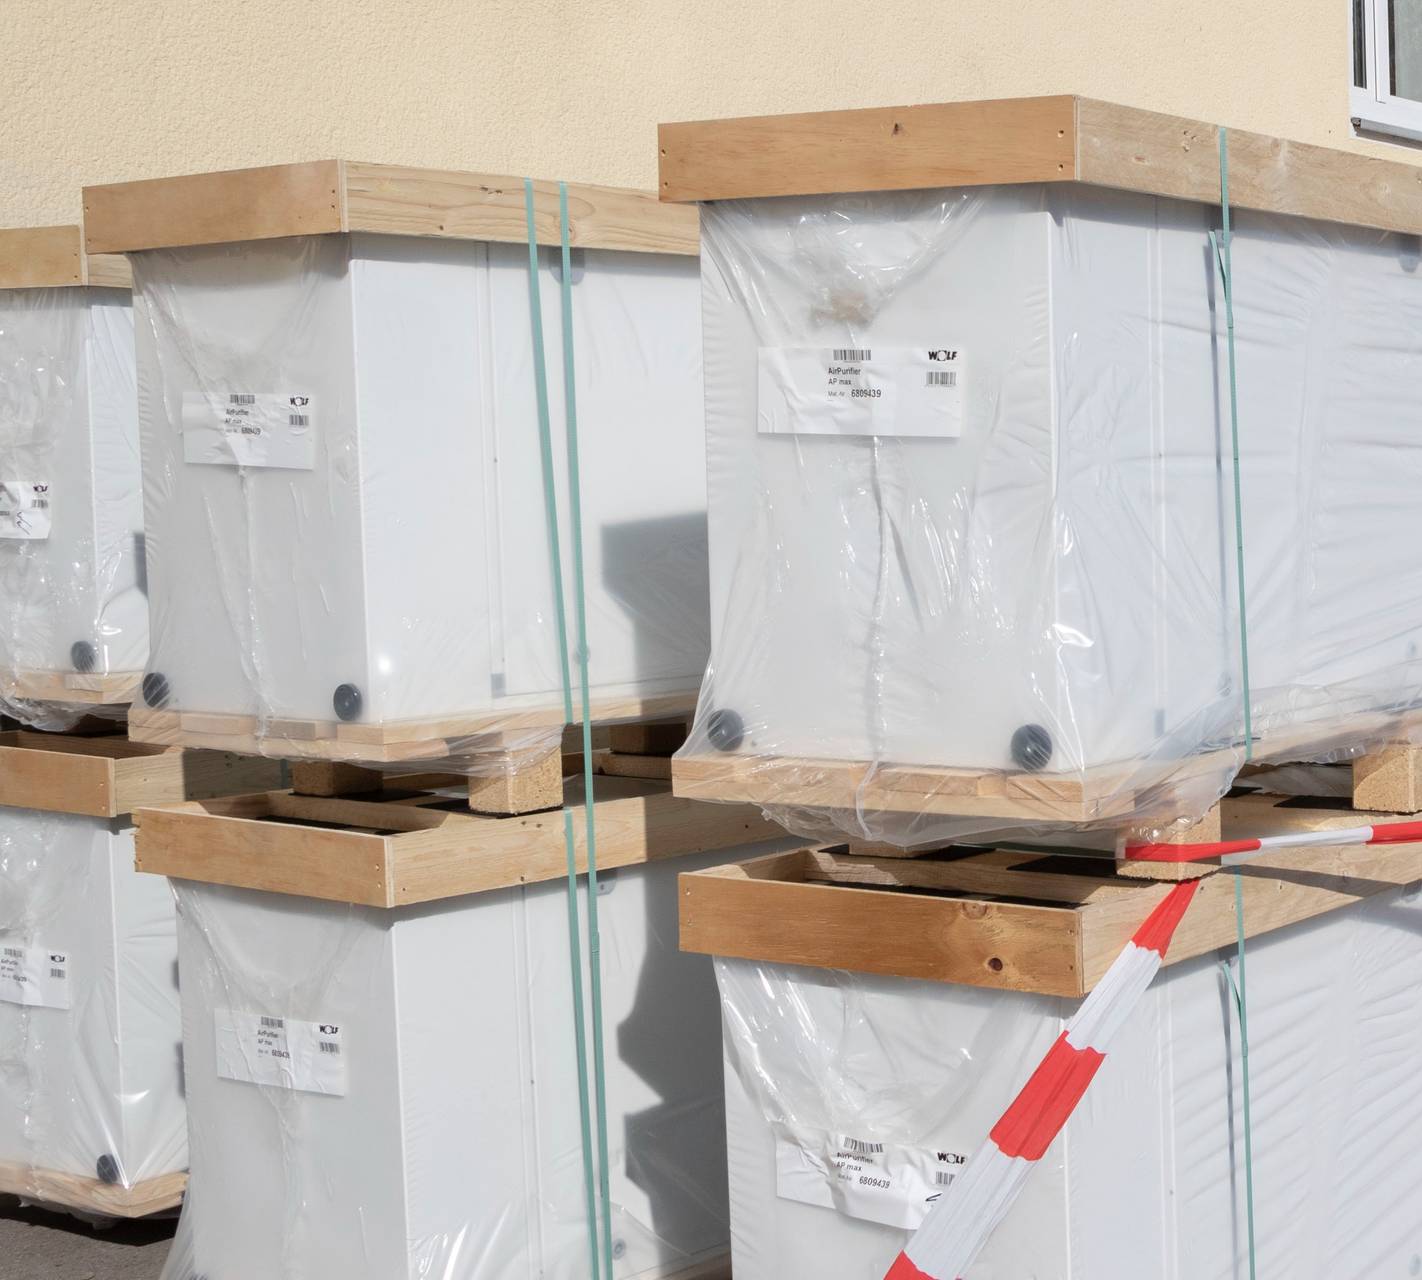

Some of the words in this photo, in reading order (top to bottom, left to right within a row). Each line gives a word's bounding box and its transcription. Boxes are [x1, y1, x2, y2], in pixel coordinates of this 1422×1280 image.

[928, 350, 957, 361] WOLF
[828, 367, 861, 376] AirPurifier
[851, 389, 882, 398] 6809439
[937, 1152, 965, 1165] WOLF
[846, 1164, 862, 1172] max
[859, 1176, 891, 1189] 6809439
